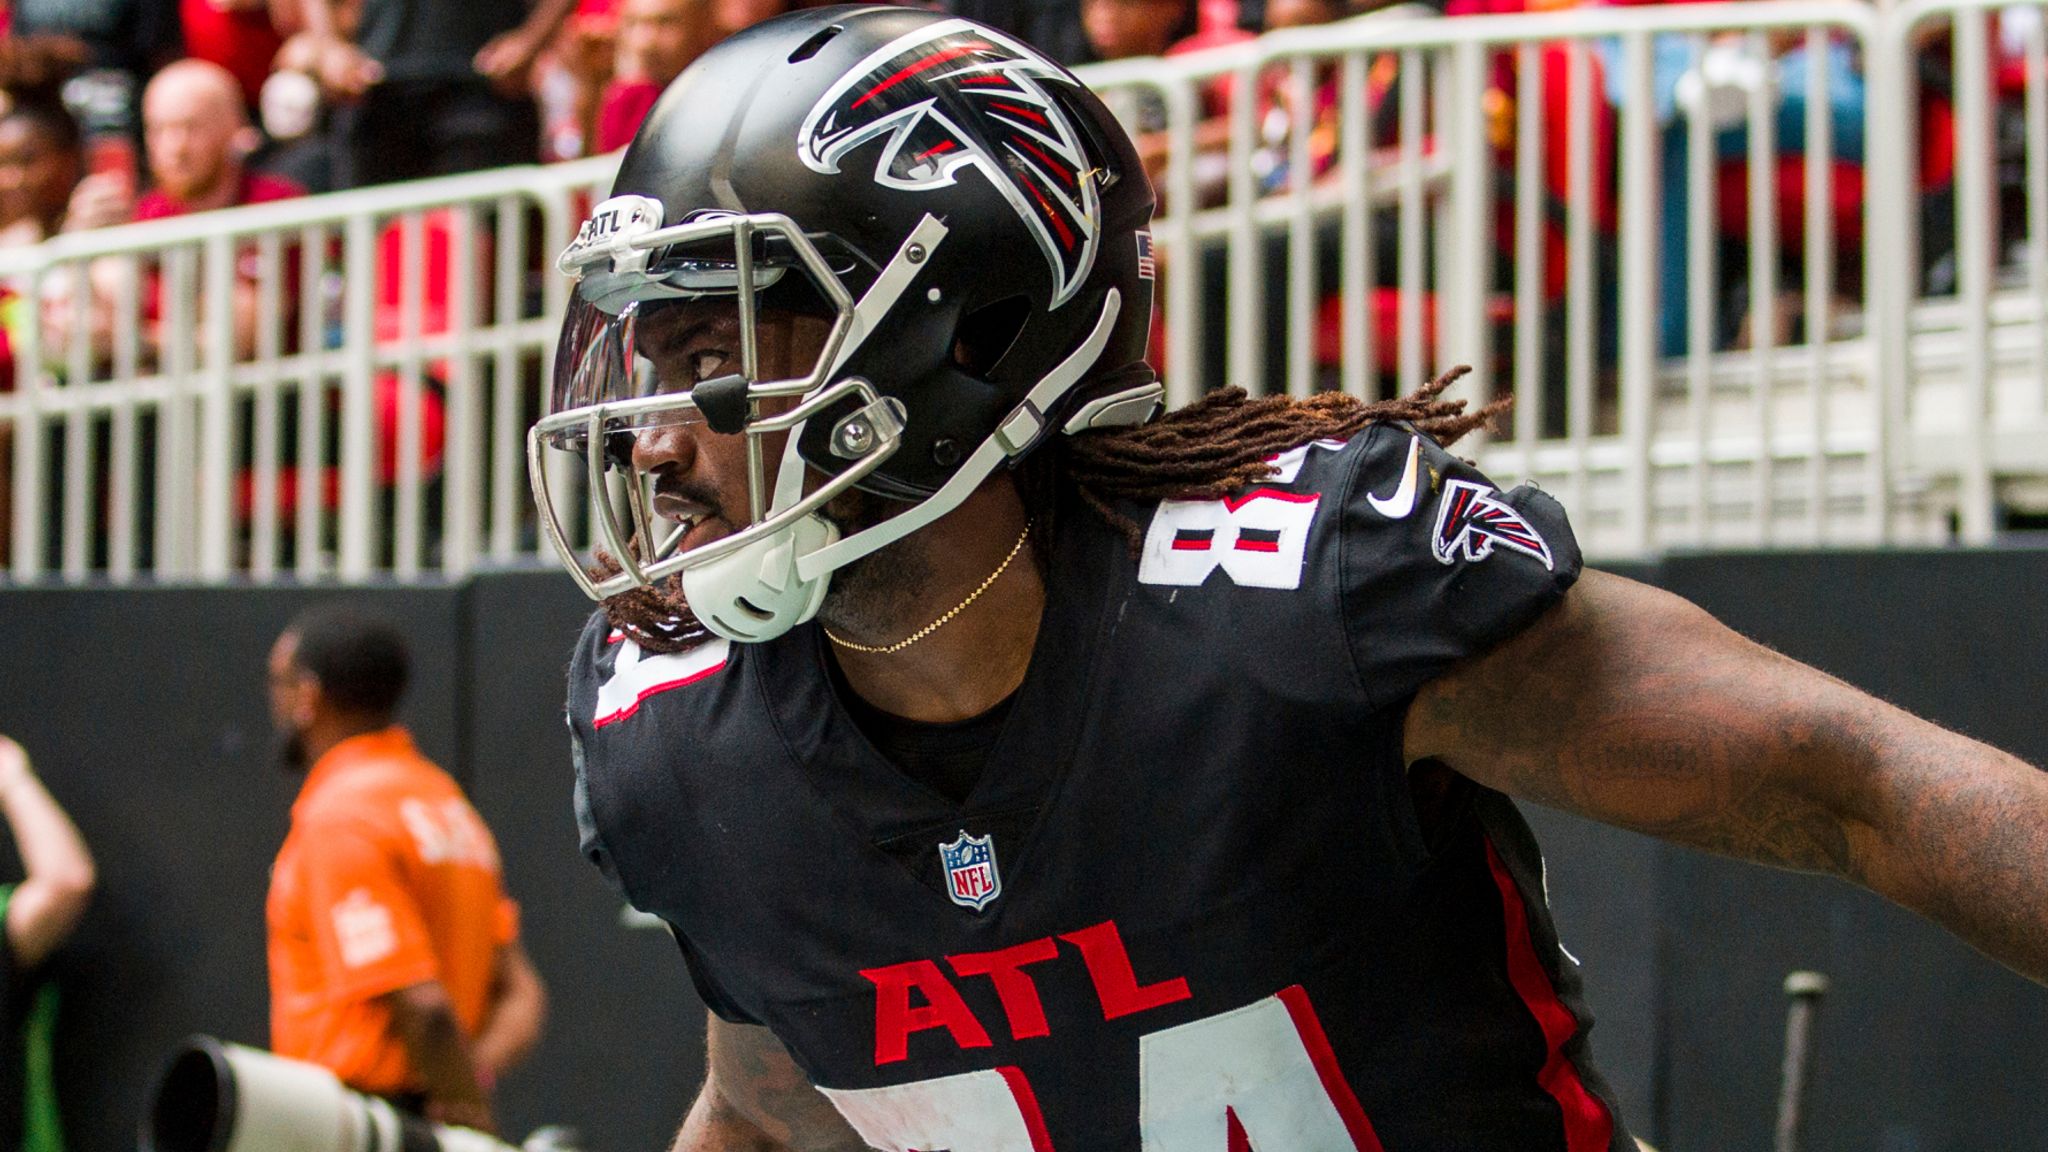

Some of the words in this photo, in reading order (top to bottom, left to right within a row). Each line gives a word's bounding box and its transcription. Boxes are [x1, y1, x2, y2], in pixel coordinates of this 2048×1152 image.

[587, 209, 621, 241] ATL
[952, 865, 994, 898] NFL
[858, 919, 1193, 1066] ATL
